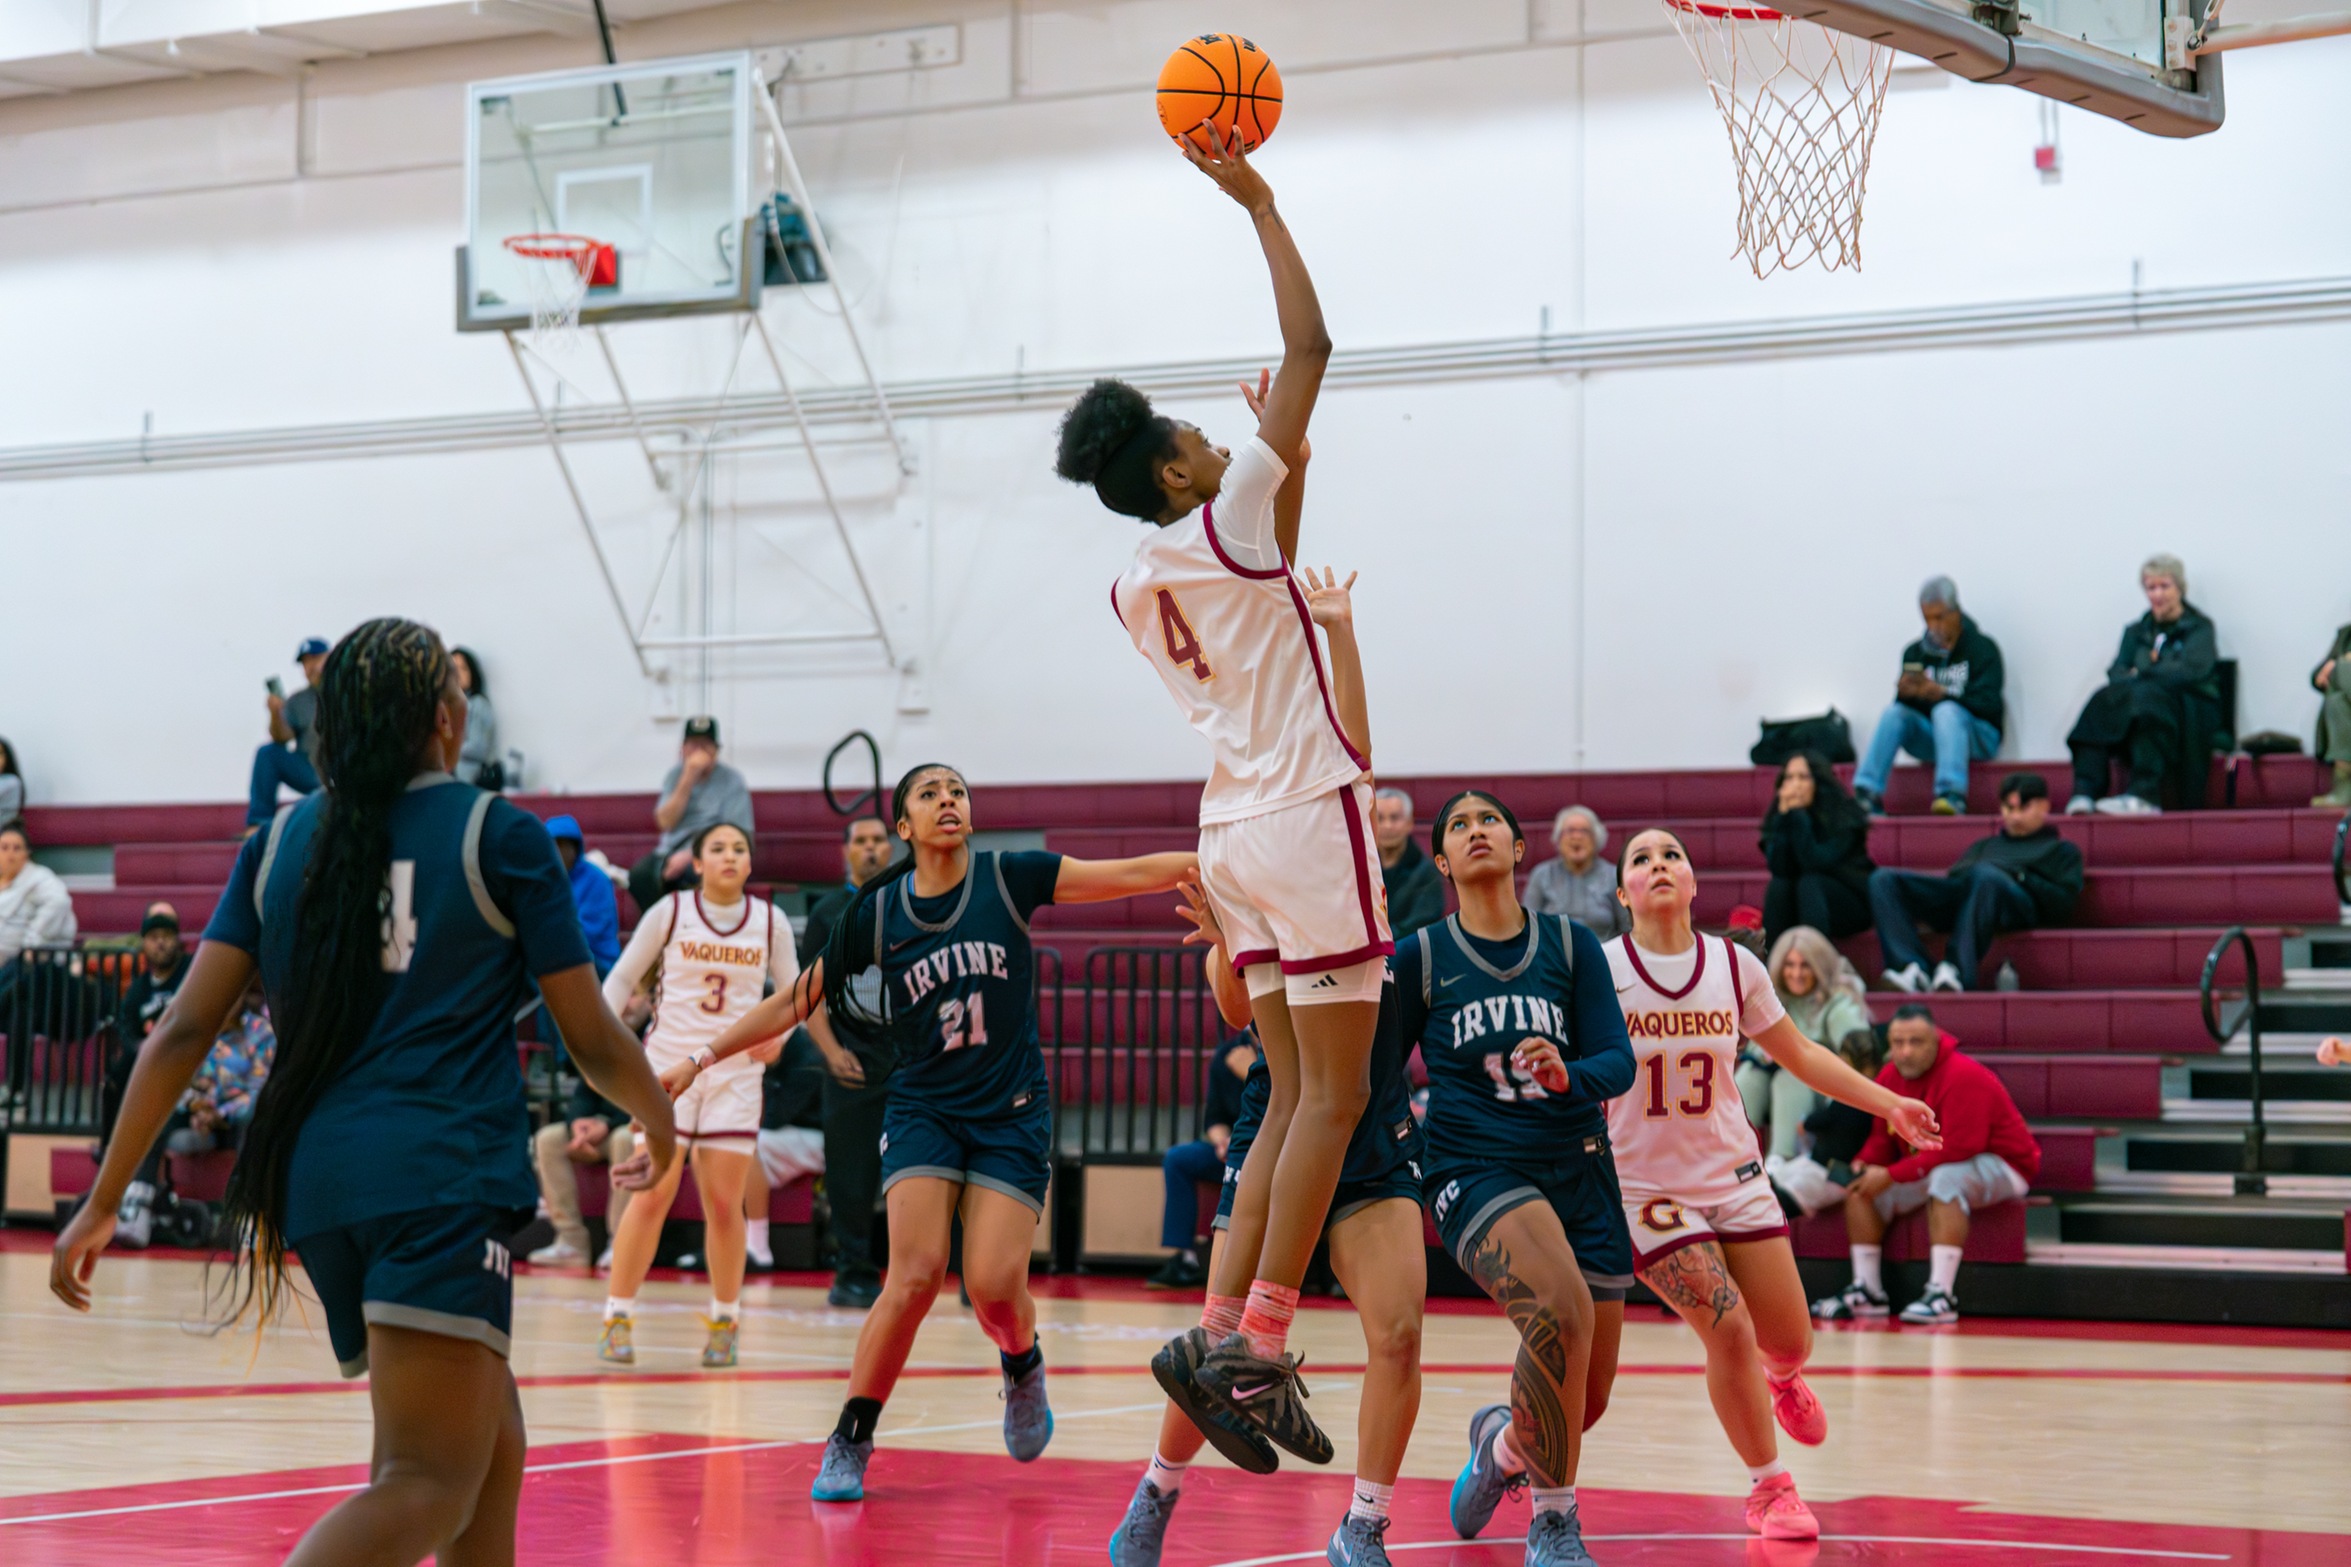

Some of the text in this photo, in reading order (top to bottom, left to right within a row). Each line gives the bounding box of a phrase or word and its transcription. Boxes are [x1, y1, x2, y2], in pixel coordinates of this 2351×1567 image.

[1152, 585, 1217, 685] 4
[700, 969, 729, 1016] 3
[903, 941, 1008, 1006] IRVINE
[938, 990, 988, 1052] 21
[1451, 994, 1570, 1050] IRVINE
[1642, 1048, 1718, 1121] 13
[1638, 1197, 1690, 1236] G
